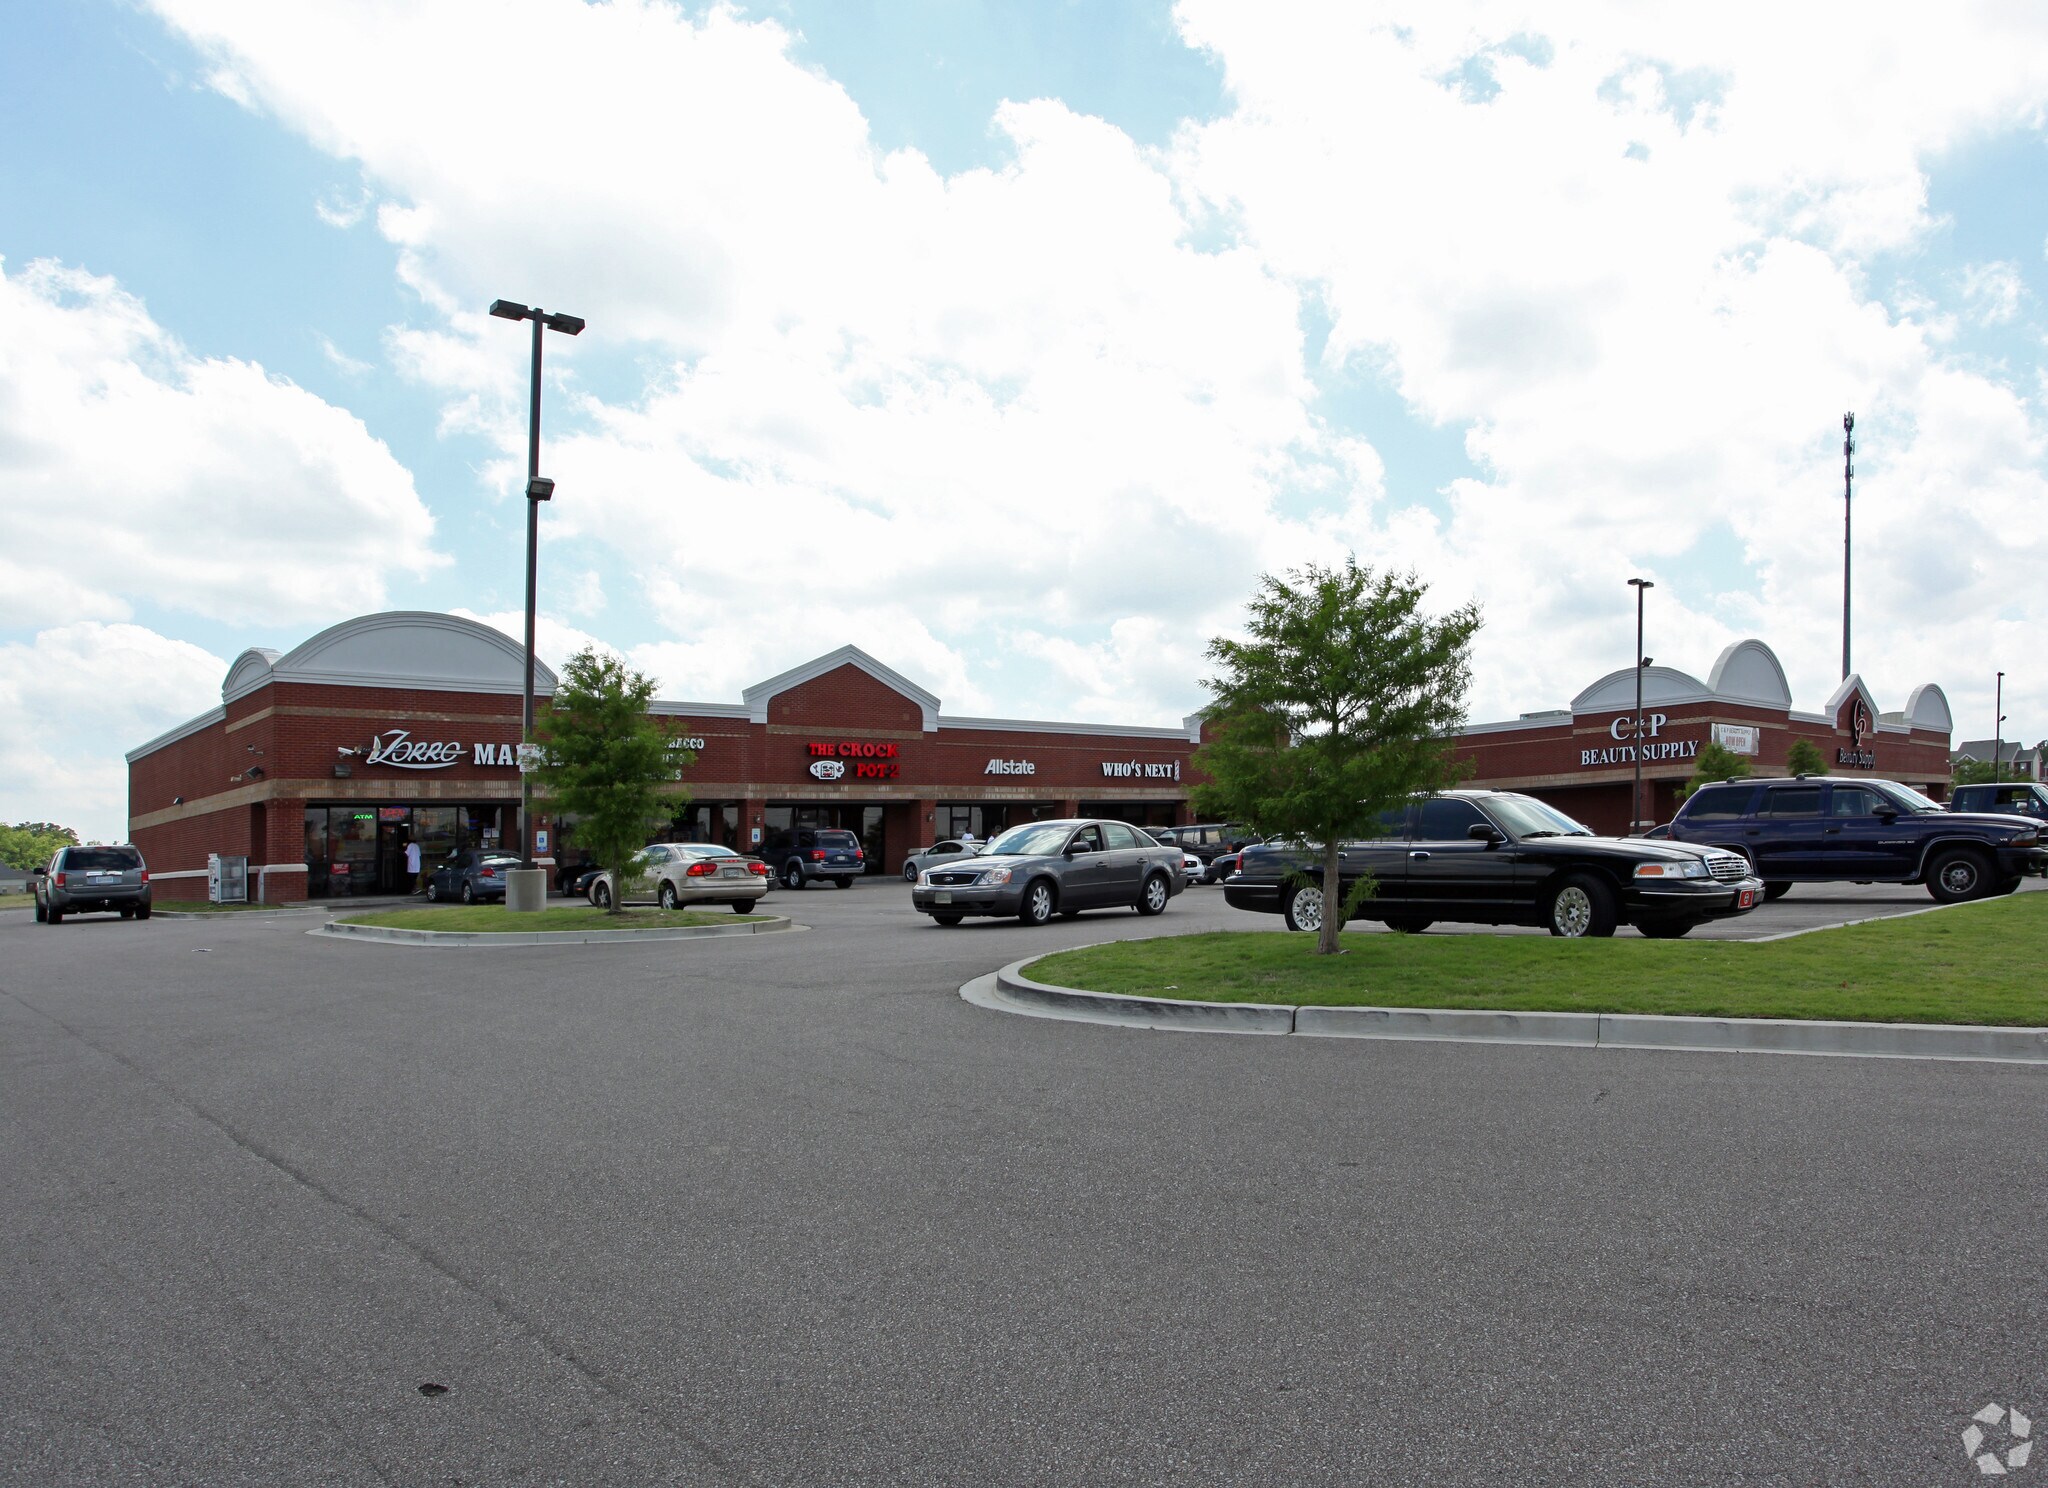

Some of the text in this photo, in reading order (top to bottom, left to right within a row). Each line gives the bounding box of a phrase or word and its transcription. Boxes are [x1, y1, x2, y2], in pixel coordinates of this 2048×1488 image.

[808, 742, 900, 758] THE CROCK
[1581, 740, 1699, 766] BEAUTY SUPPLY
[856, 763, 900, 778] POT 2
[984, 759, 1035, 775] Allstate
[1102, 759, 1173, 778] WHO'S NEXT
